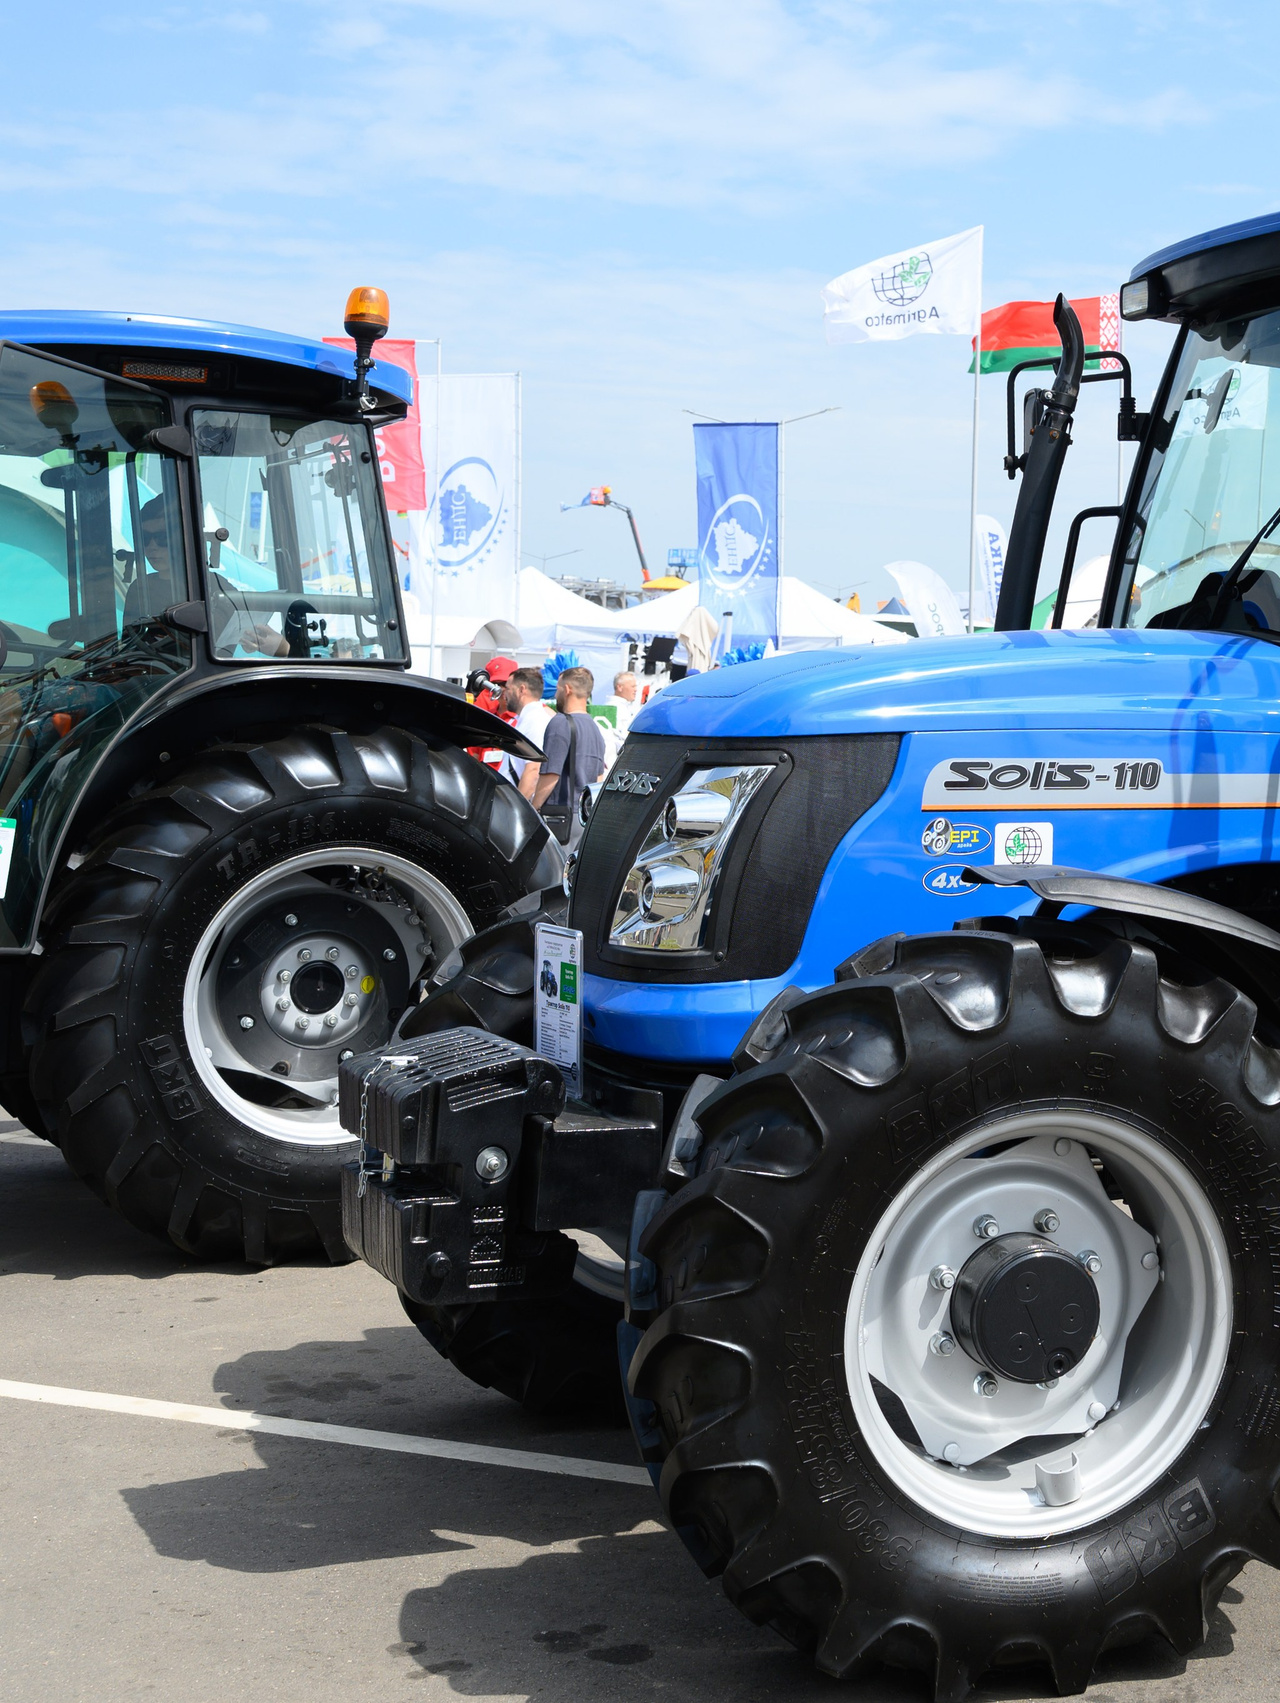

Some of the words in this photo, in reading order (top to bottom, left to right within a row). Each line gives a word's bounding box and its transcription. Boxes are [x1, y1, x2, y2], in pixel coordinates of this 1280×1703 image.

[950, 830, 980, 843] EPI
[142, 1038, 201, 1117] BKT
[1088, 1480, 1214, 1600] BKT
